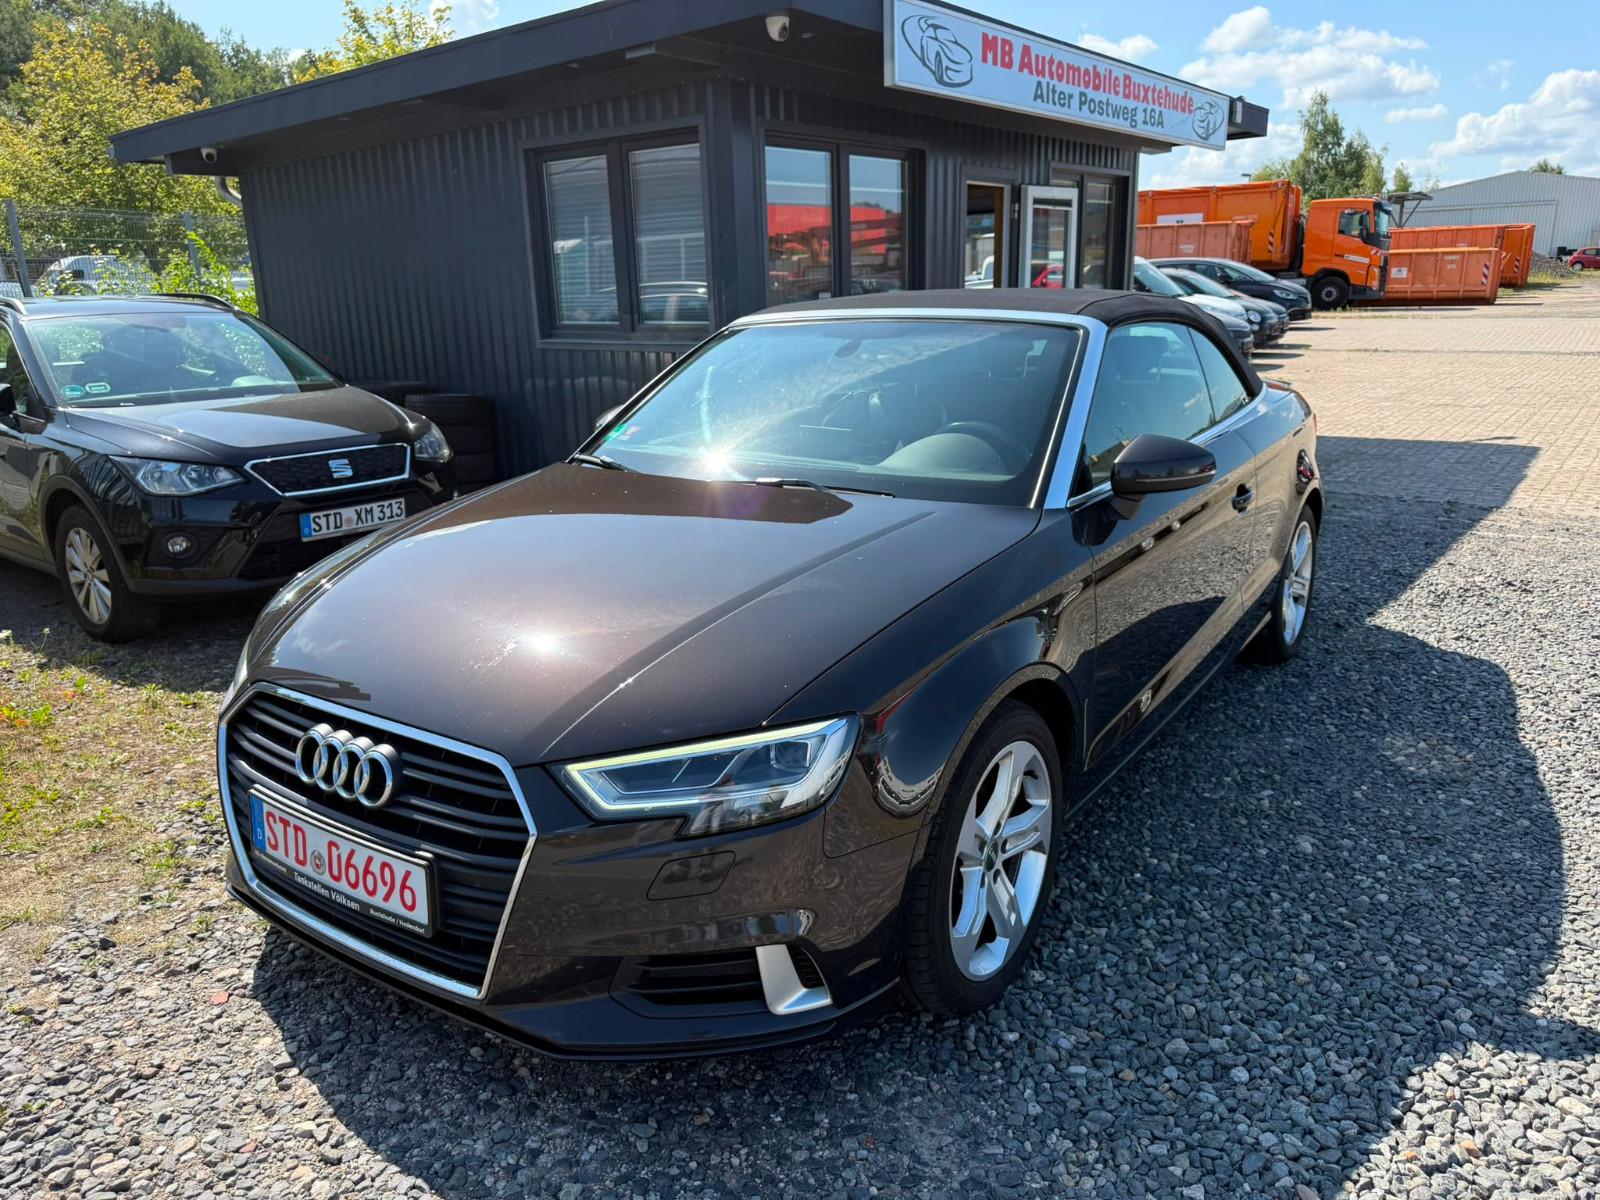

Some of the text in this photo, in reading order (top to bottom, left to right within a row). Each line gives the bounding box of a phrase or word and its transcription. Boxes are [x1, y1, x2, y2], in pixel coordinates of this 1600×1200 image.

[981, 32, 1014, 70] MB
[1033, 80, 1165, 129] Alter Postweg 16A
[312, 511, 343, 533] STD
[354, 506, 375, 526] XM
[377, 500, 405, 521] 313
[257, 828, 263, 840] D
[265, 811, 308, 868] STD
[327, 839, 417, 913] 06696
[294, 871, 330, 898] Tankstellen
